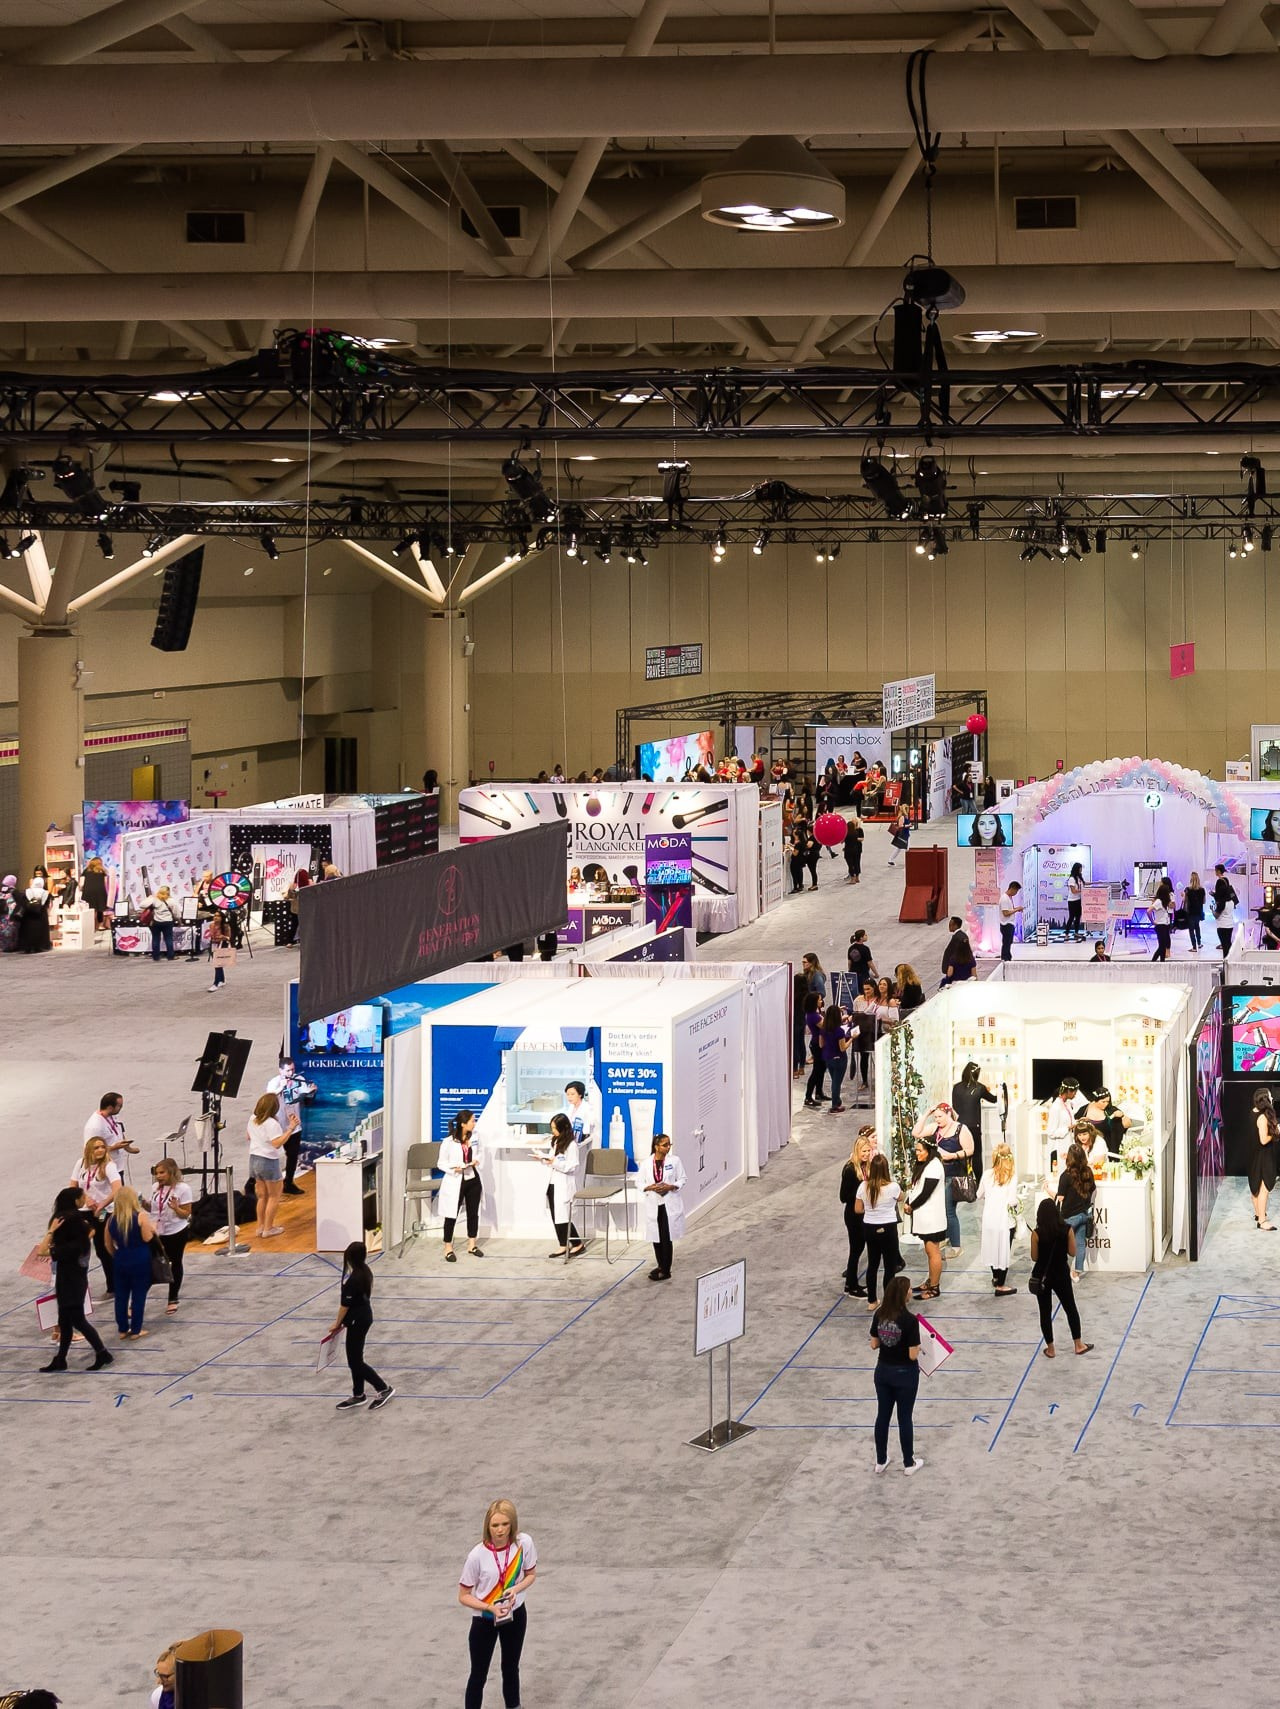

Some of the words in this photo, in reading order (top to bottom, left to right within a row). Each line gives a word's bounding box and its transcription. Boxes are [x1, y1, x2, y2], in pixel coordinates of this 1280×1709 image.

[819, 733, 882, 746] smashbox
[1040, 778, 1124, 820] ABSOLUTE
[575, 823, 646, 840] ROYAL
[278, 849, 298, 871] dirty
[689, 1021, 700, 1036] THE
[700, 1013, 714, 1030] FACE
[713, 1006, 728, 1023] SHOP
[608, 1068, 635, 1078] SAVE
[637, 1068, 658, 1078] 30%
[1085, 1235, 1112, 1249] etra
